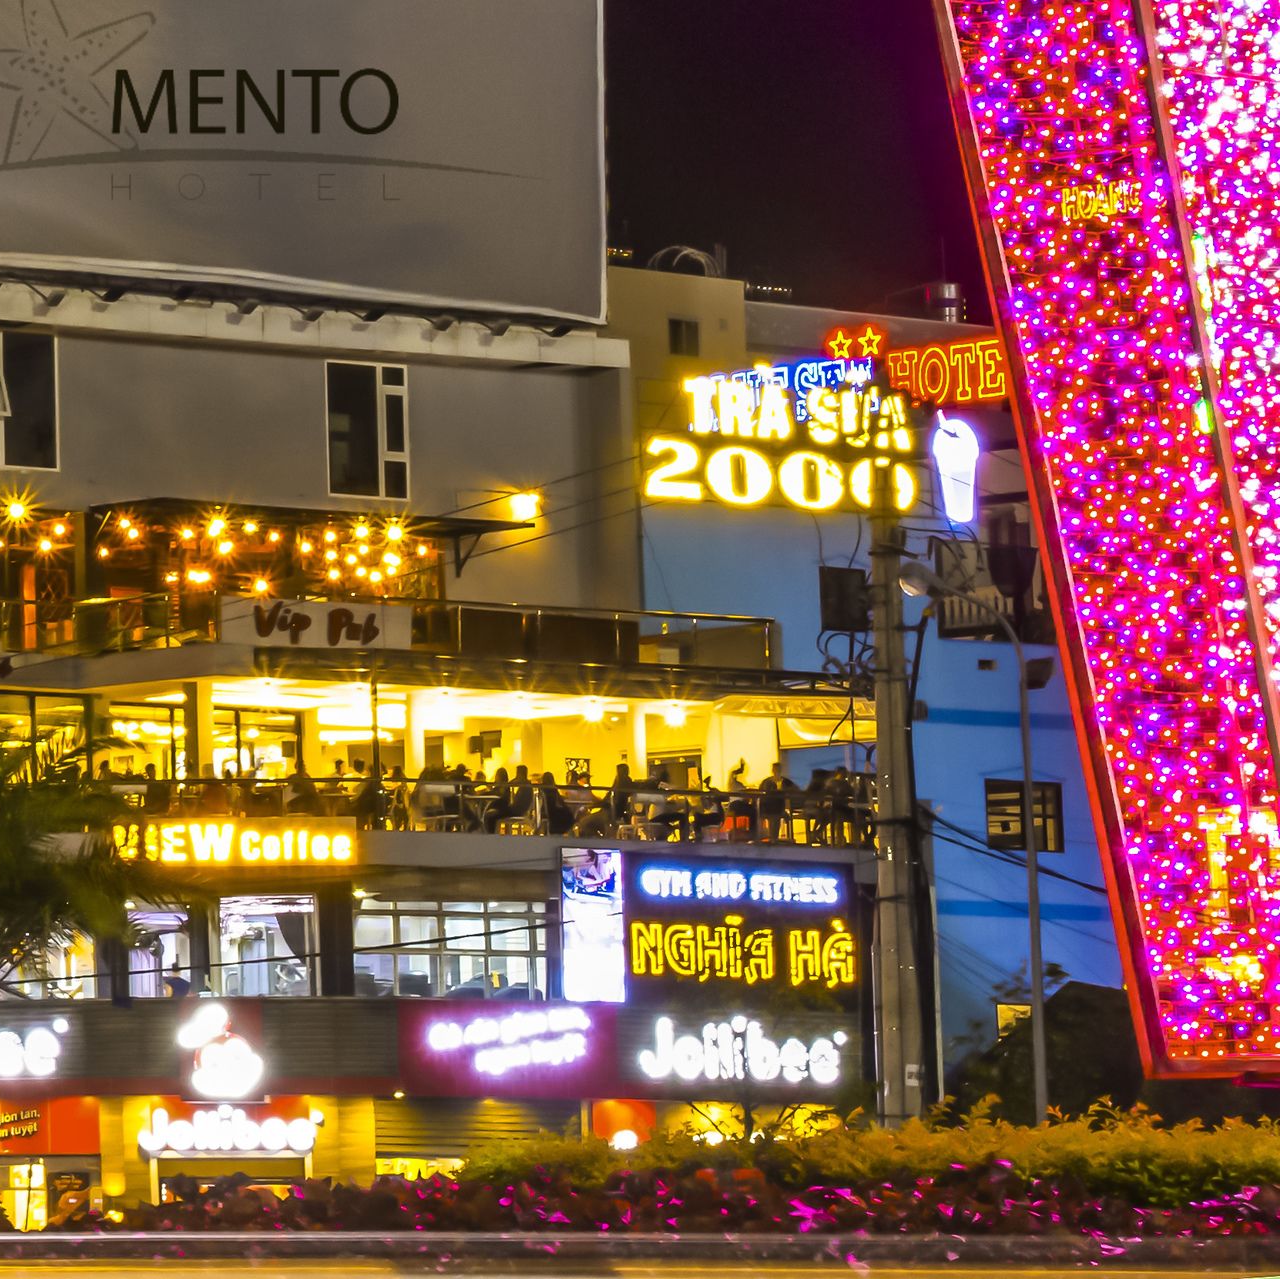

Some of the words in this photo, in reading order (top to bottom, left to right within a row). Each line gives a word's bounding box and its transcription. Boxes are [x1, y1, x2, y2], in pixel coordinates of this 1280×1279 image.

[110, 67, 400, 135] MENTO
[110, 172, 402, 202] HOTEL
[643, 436, 917, 511] 2000
[253, 601, 312, 646] Vip
[327, 608, 380, 647] Pub
[239, 829, 352, 861] Coffee
[638, 1014, 841, 1084] Jollibee
[137, 1103, 317, 1151] Jollibee
